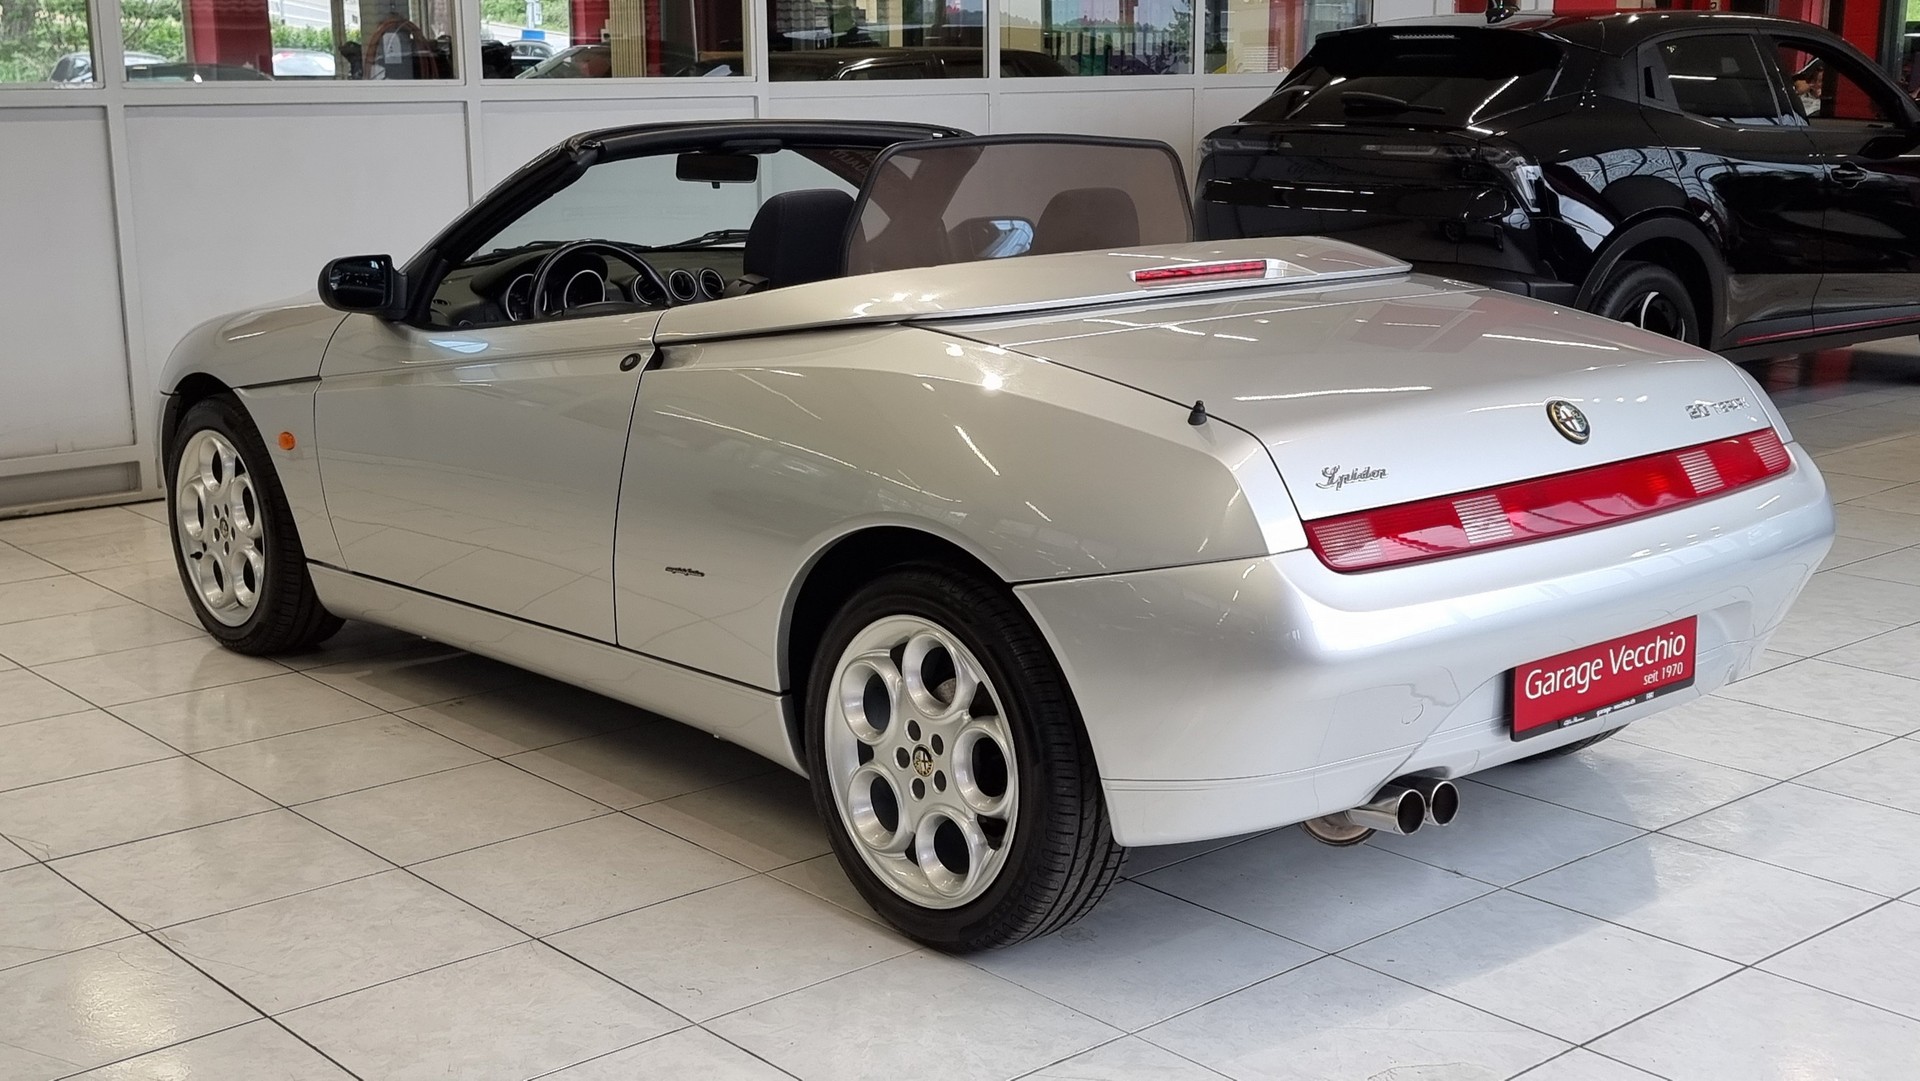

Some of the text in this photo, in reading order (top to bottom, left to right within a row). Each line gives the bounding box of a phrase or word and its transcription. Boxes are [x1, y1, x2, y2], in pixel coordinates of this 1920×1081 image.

[1525, 631, 1686, 700] Garage Vecchio
[1643, 661, 1684, 686] seit 1970
